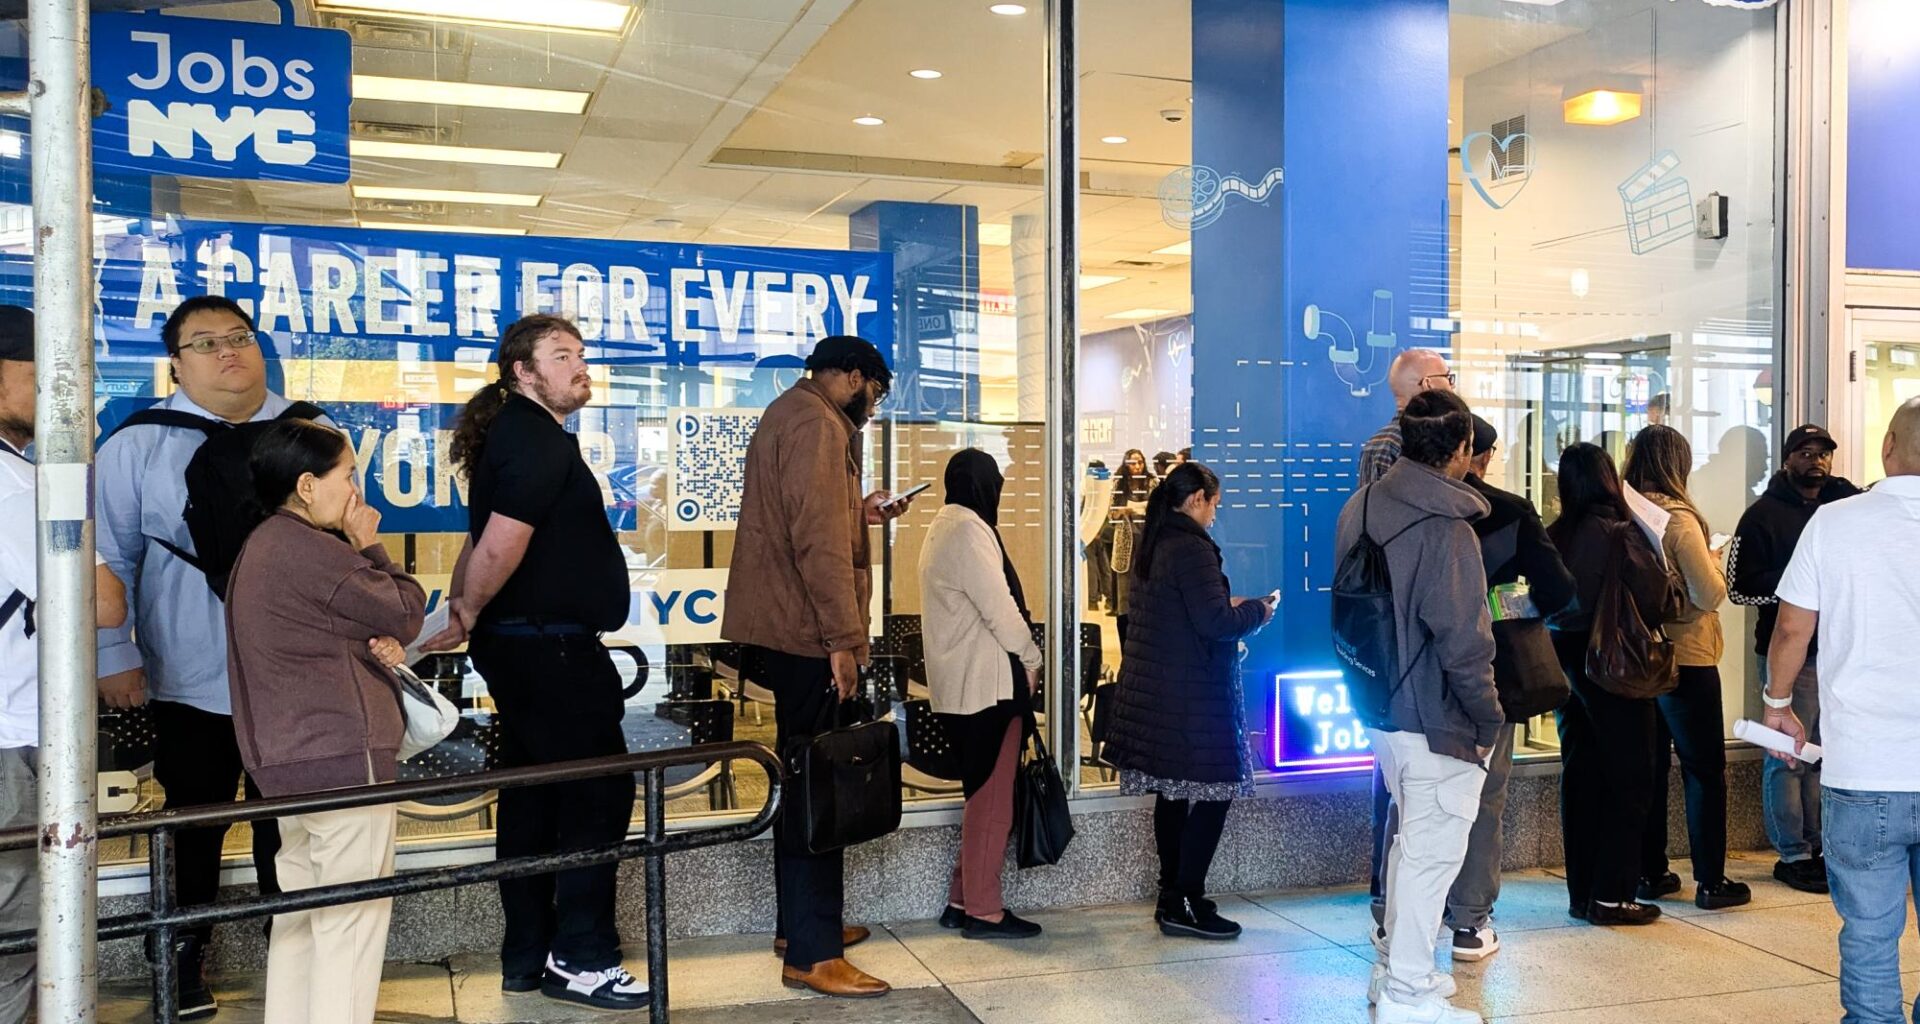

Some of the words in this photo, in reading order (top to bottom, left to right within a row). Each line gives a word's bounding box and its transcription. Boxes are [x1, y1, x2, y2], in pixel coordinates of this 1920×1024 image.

[127, 30, 315, 100] Jobs
[127, 99, 316, 165] NYC
[134, 246, 183, 329] A
[206, 248, 501, 338] CAREER
[522, 262, 650, 342] FOR
[670, 267, 872, 345] EVERY
[1295, 683, 1352, 716] Wel
[1313, 718, 1370, 755] Job
